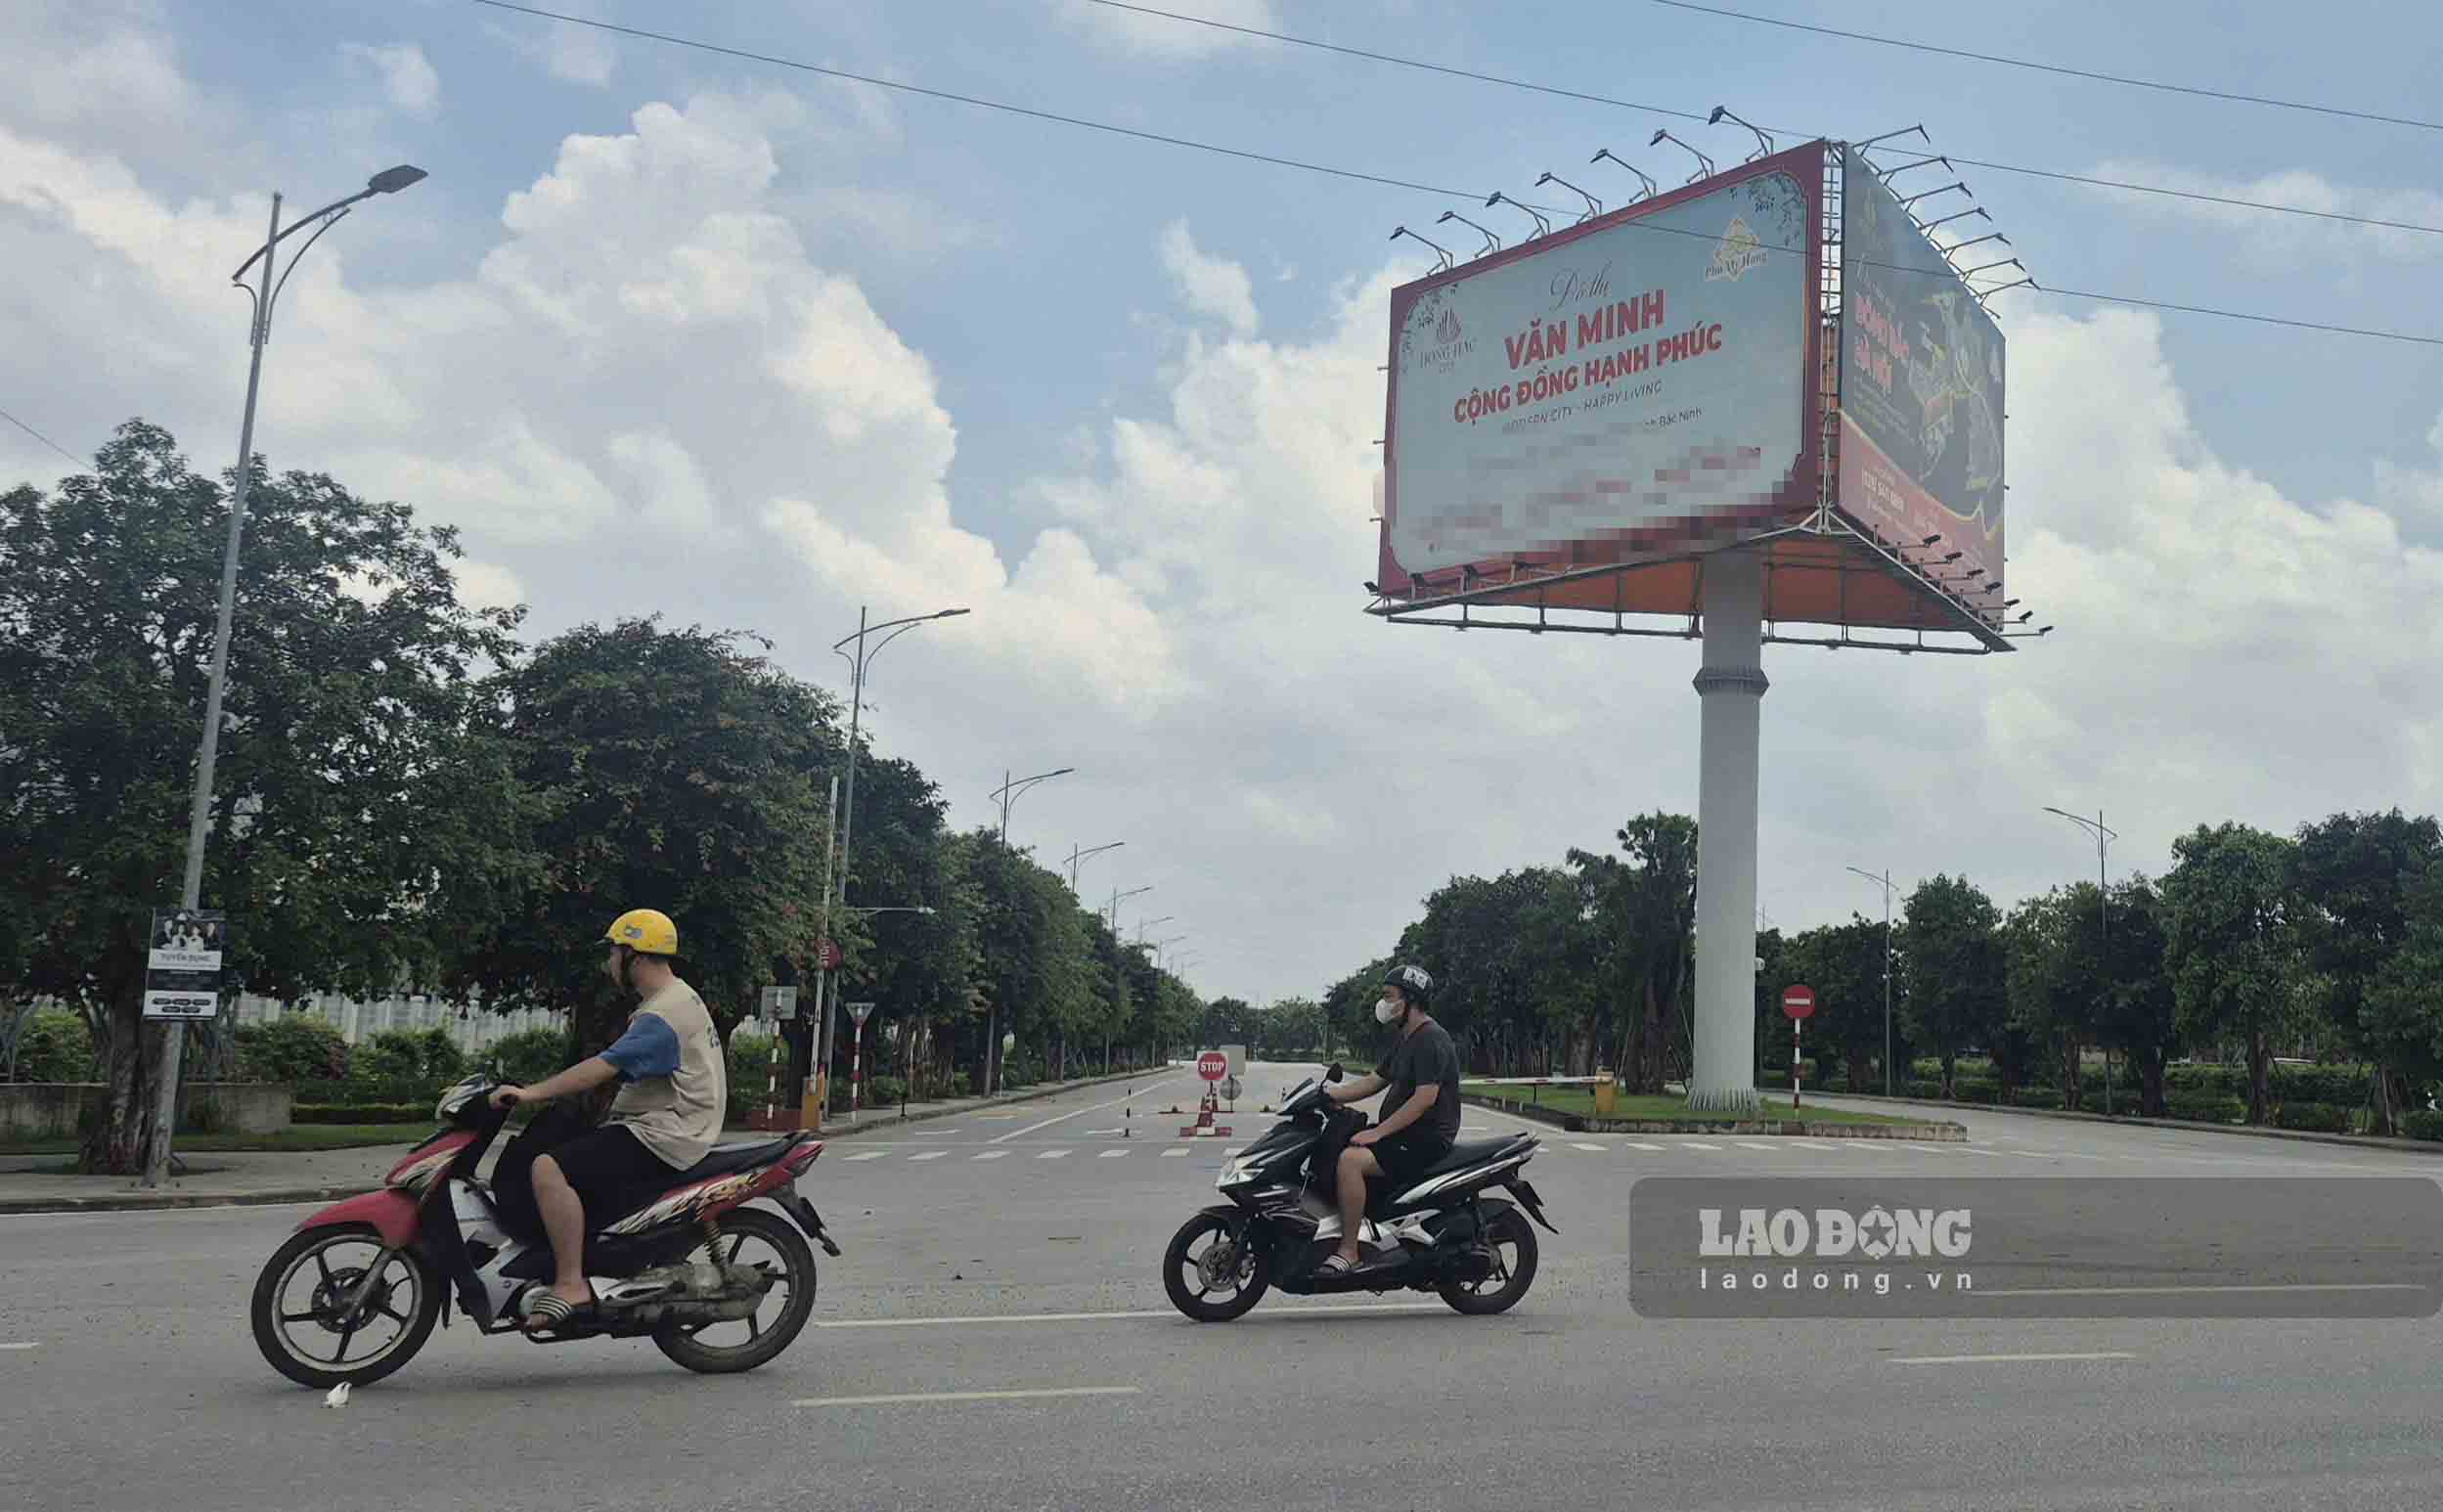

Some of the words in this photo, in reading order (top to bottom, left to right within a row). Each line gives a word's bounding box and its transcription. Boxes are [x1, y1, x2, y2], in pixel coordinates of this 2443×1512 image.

[1504, 318, 1568, 371] VĂN
[1577, 289, 1665, 350] MINH
[1454, 384, 1511, 425] CỘNG
[1516, 365, 1578, 407] ĐỒNG
[1584, 343, 1650, 388] HẠNH
[1657, 320, 1722, 367] PHÚC
[1549, 406, 1574, 422] CITY
[1583, 391, 1621, 413] HAPPY
[1623, 379, 1662, 402] LIVING
[1678, 406, 1703, 423] Ninh
[1200, 1062, 1224, 1073] STOP
